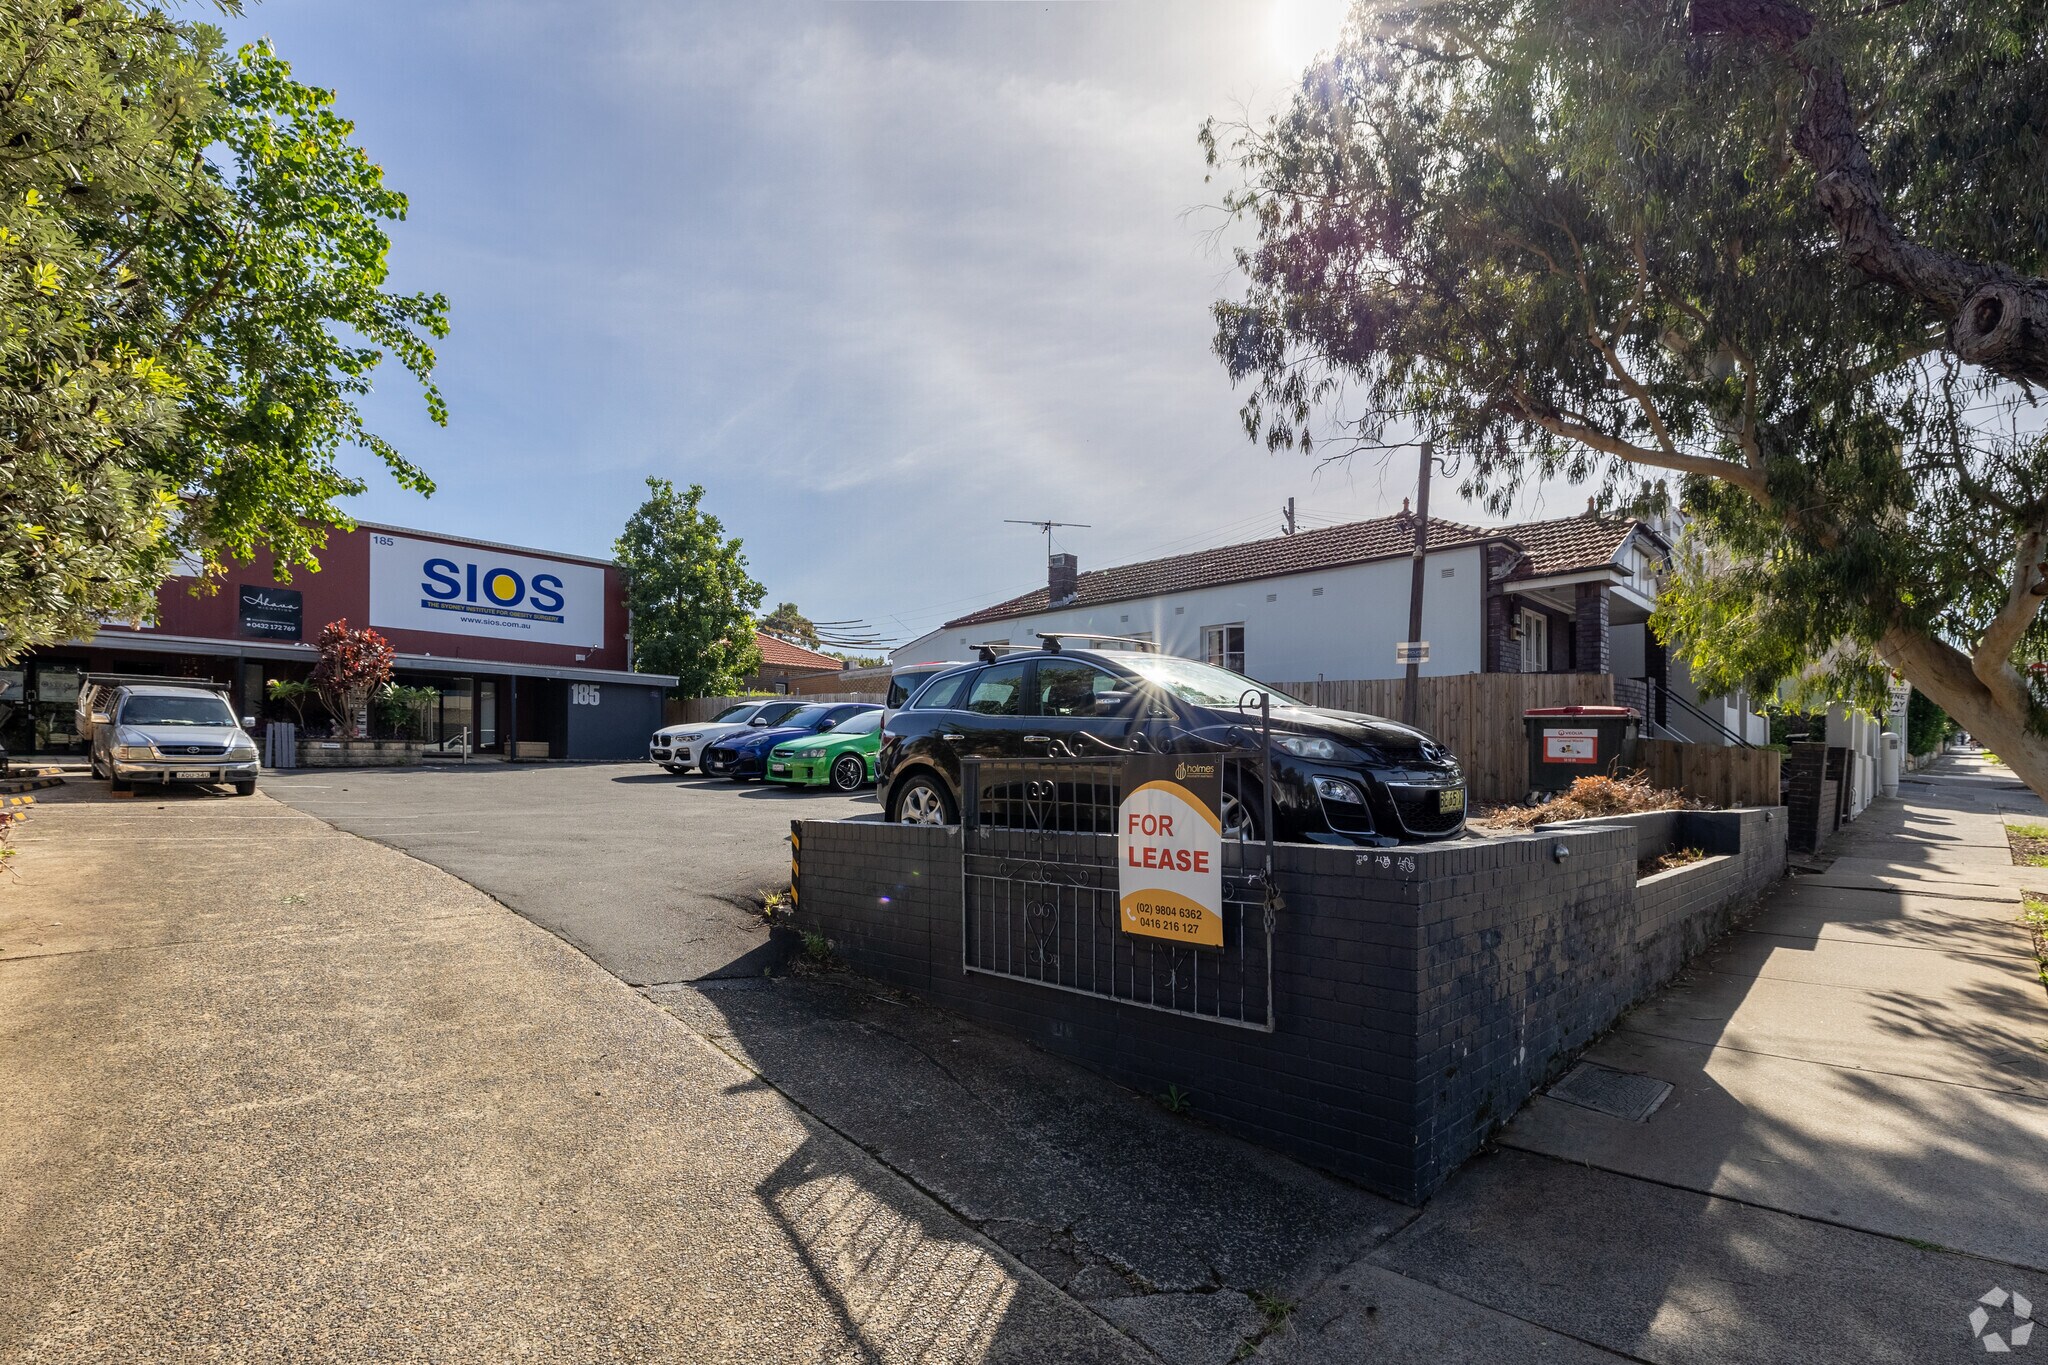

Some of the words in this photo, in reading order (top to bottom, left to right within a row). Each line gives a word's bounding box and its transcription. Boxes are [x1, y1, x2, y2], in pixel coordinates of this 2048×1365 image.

[373, 536, 393, 546] 185
[421, 558, 564, 612] SIOS
[441, 603, 465, 611] SYDNEY
[466, 606, 496, 615] INSTITUTE
[509, 611, 533, 619] OBESITY
[533, 613, 559, 621] SURGERY
[251, 622, 269, 630] 0432
[461, 616, 531, 630] www.sios.com.au
[571, 683, 600, 706] 185
[1187, 764, 1215, 773] holmes
[1128, 814, 1174, 837] FOR
[1128, 846, 1210, 873] LEASE
[1136, 902, 1153, 916] (02)
[1155, 904, 1177, 918] 9804
[1179, 906, 1202, 920] 6362
[1140, 917, 1161, 929] 0416
[1163, 919, 1180, 932] 216
[1182, 922, 1199, 934] 127
